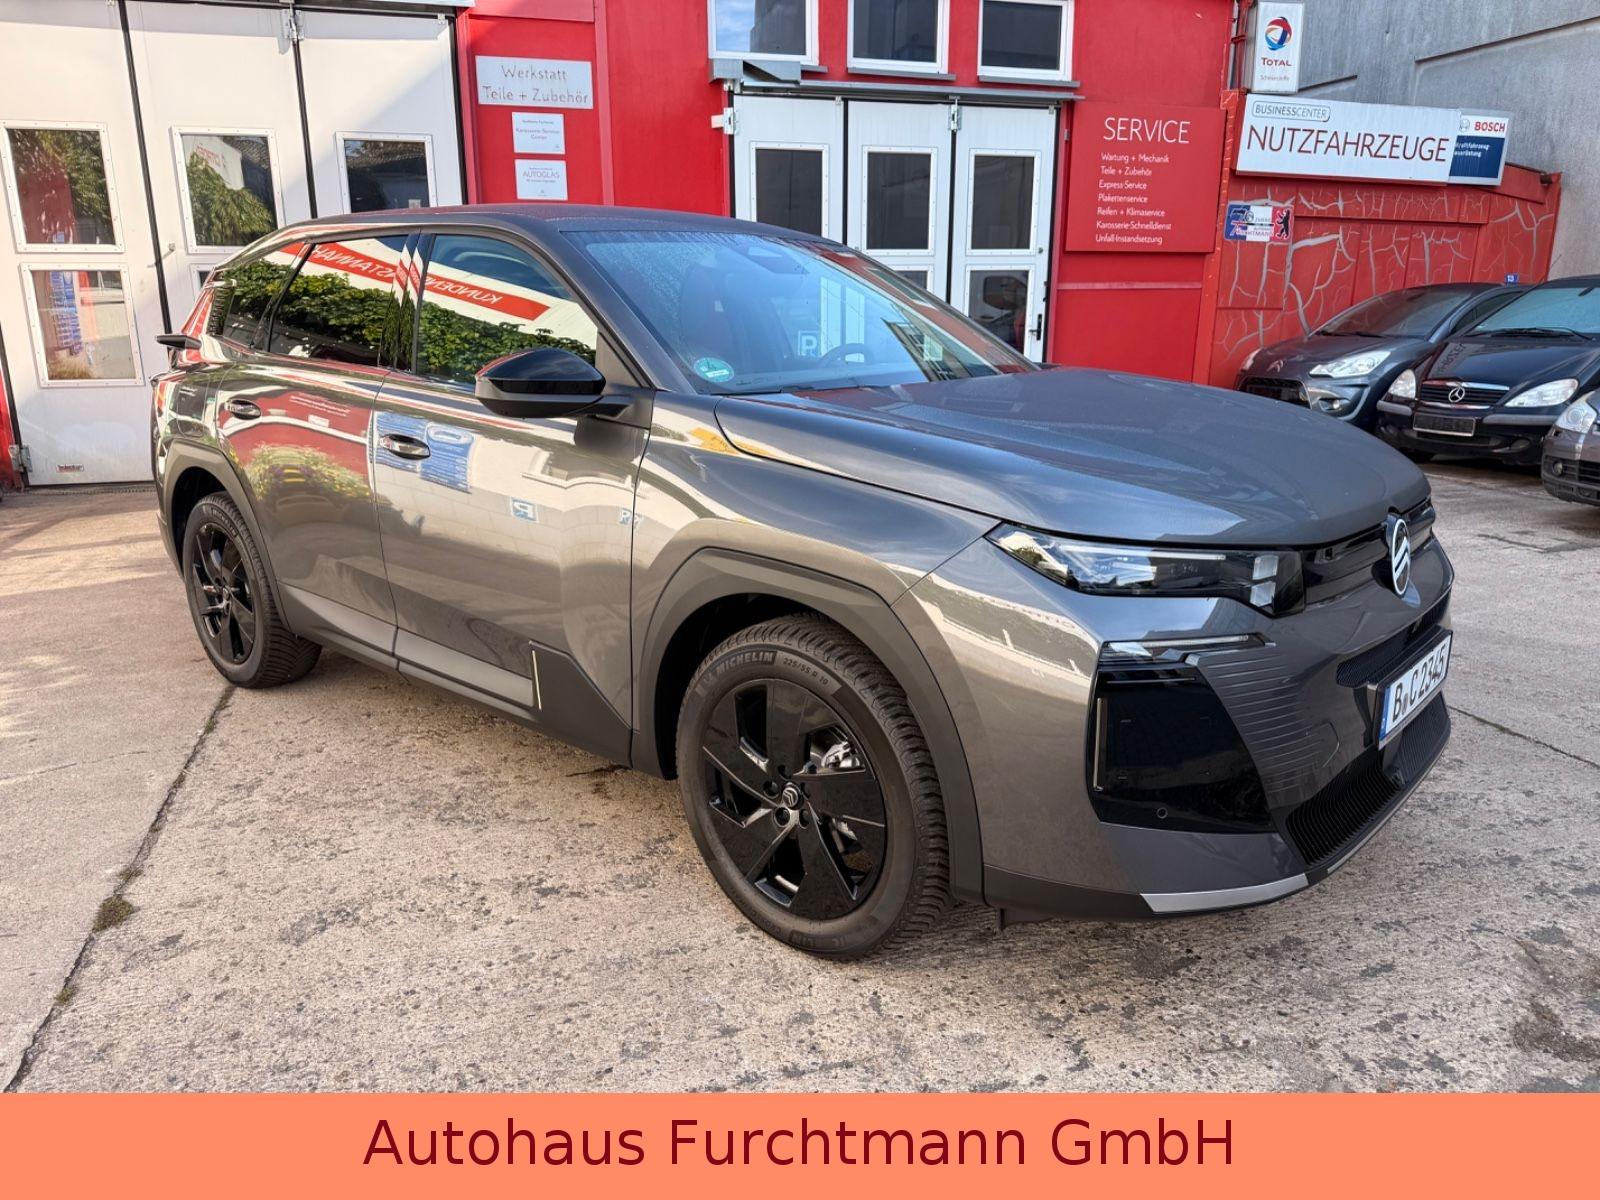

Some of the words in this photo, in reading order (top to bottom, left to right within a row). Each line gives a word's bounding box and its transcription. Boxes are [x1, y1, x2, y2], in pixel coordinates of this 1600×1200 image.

[501, 64, 567, 81] Werkstatt
[482, 85, 514, 101] Teile
[519, 91, 528, 101] +
[532, 87, 589, 104] Zubehör
[1103, 117, 1190, 144] SERVICE
[1474, 121, 1506, 132] BOSCH
[1247, 125, 1449, 162] NUTZFAHRZEUGE
[1101, 153, 1129, 164] Wartung
[1138, 153, 1170, 164] Mechanik
[1100, 165, 1116, 175] Teile
[1124, 166, 1152, 176] Zubehör
[1098, 193, 1149, 204] Plakettenservice
[1097, 206, 1118, 216] Reifen
[1126, 207, 1166, 218] Klimaservice
[1096, 220, 1172, 231] Karosserie-Schnelldienst
[1095, 233, 1163, 245] Unfall-Instandsetzung
[716, 651, 774, 675] MICHELIN
[1392, 682, 1403, 723] B
